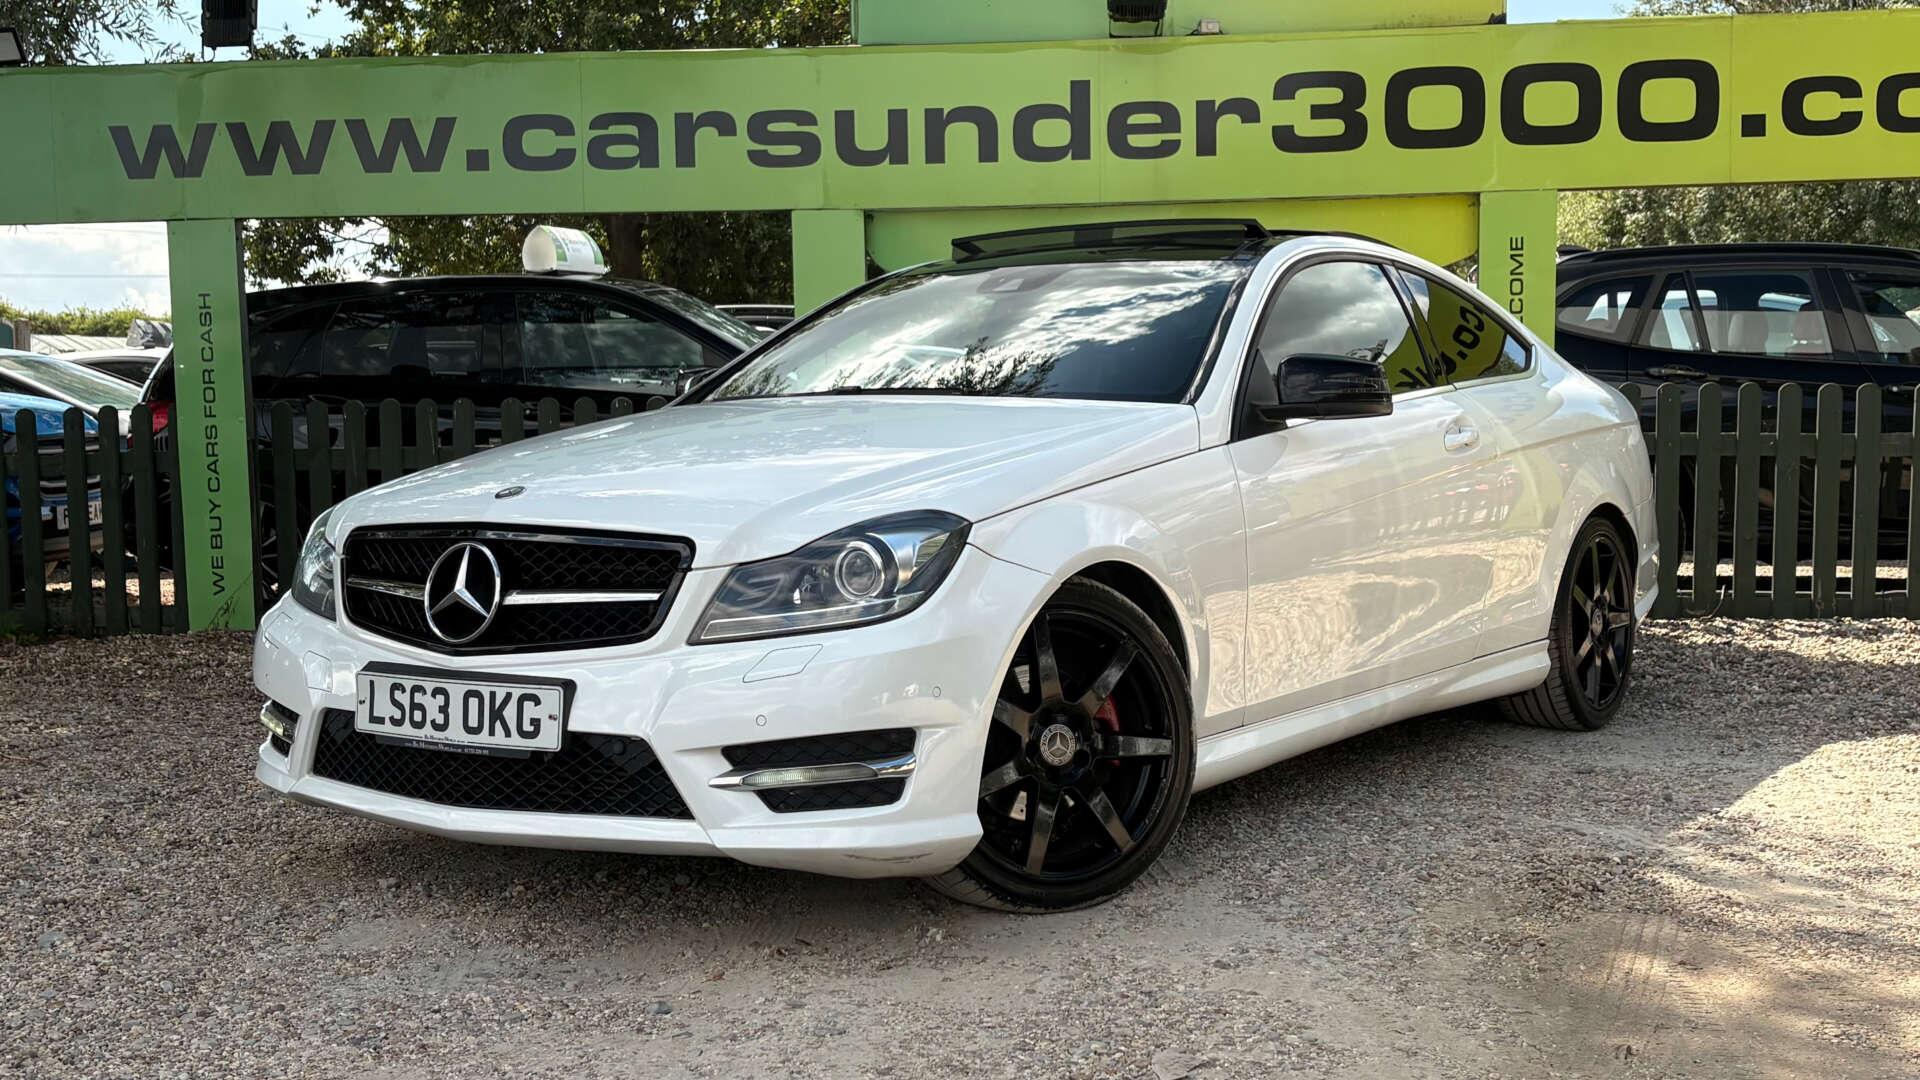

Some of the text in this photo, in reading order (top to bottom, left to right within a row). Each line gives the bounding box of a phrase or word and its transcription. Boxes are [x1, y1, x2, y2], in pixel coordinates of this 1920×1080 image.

[1509, 236, 1524, 323] COME
[199, 293, 225, 596] WE BUY CARS FOR CASH
[368, 679, 542, 740] LS63 OKG
